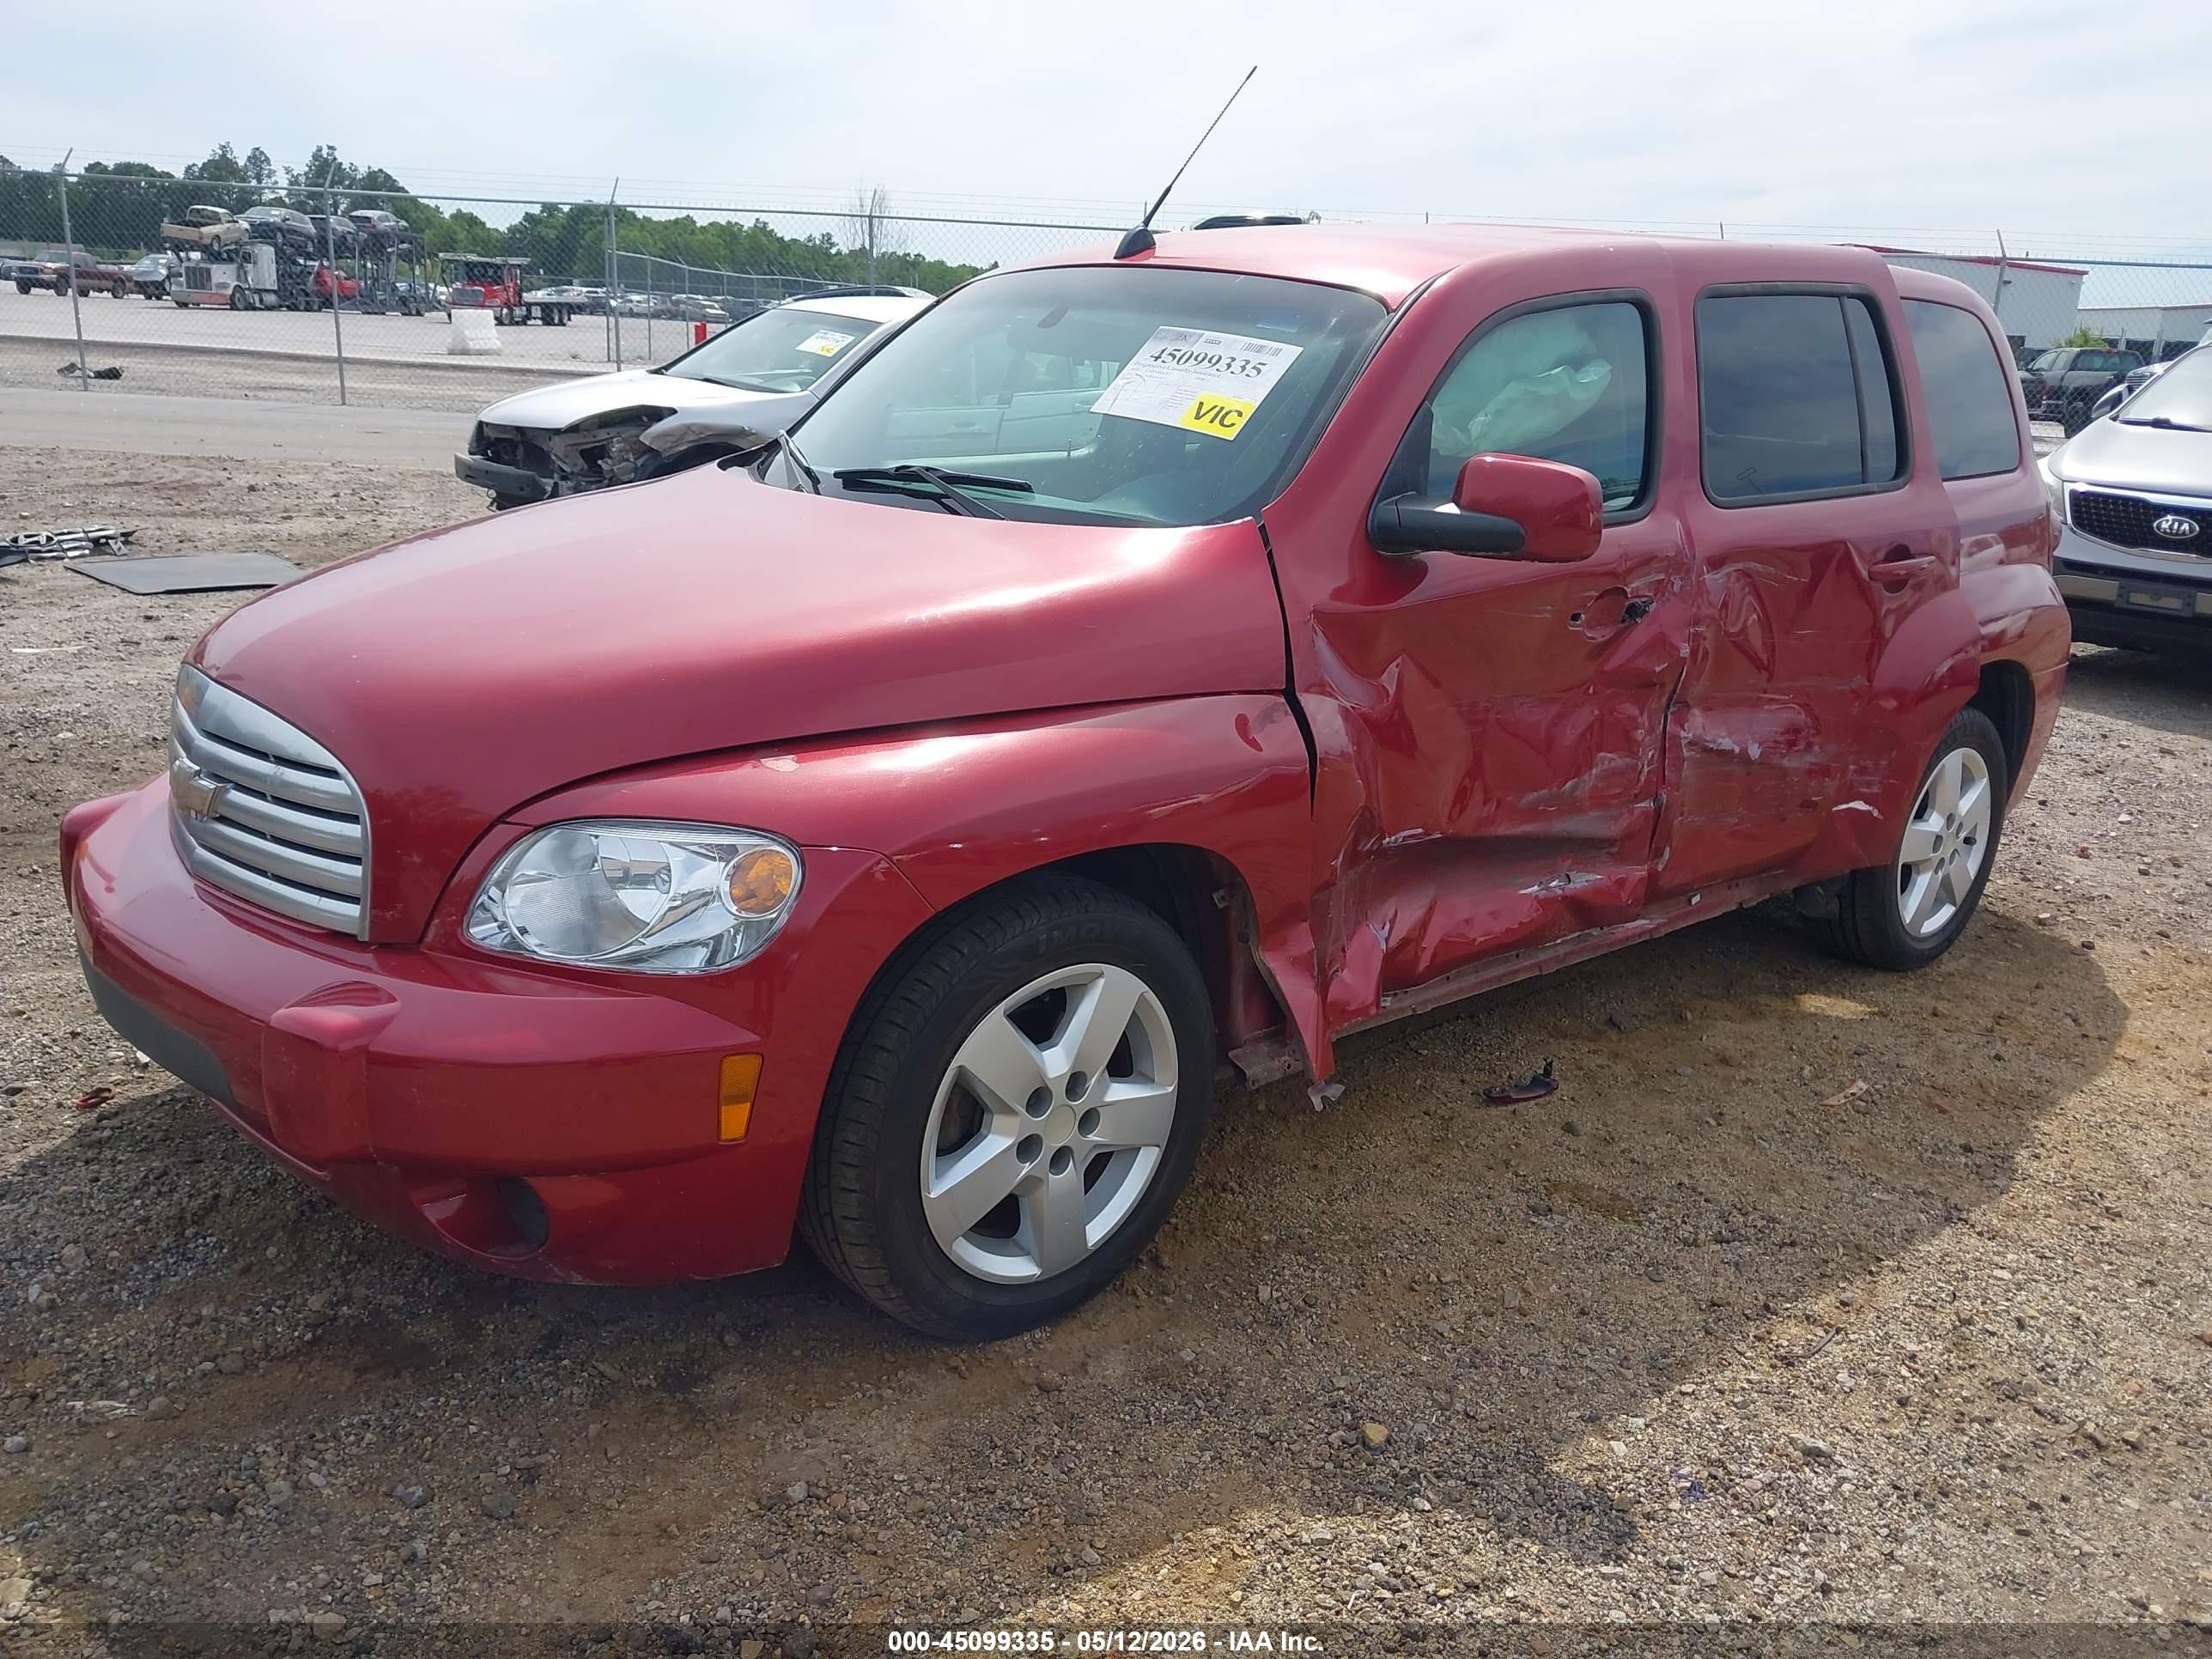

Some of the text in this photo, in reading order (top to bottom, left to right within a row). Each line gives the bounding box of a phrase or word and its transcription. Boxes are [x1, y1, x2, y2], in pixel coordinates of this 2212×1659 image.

[1149, 346, 1268, 378] 45099335
[1194, 401, 1243, 428] VIC
[2160, 520, 2191, 535] KIA
